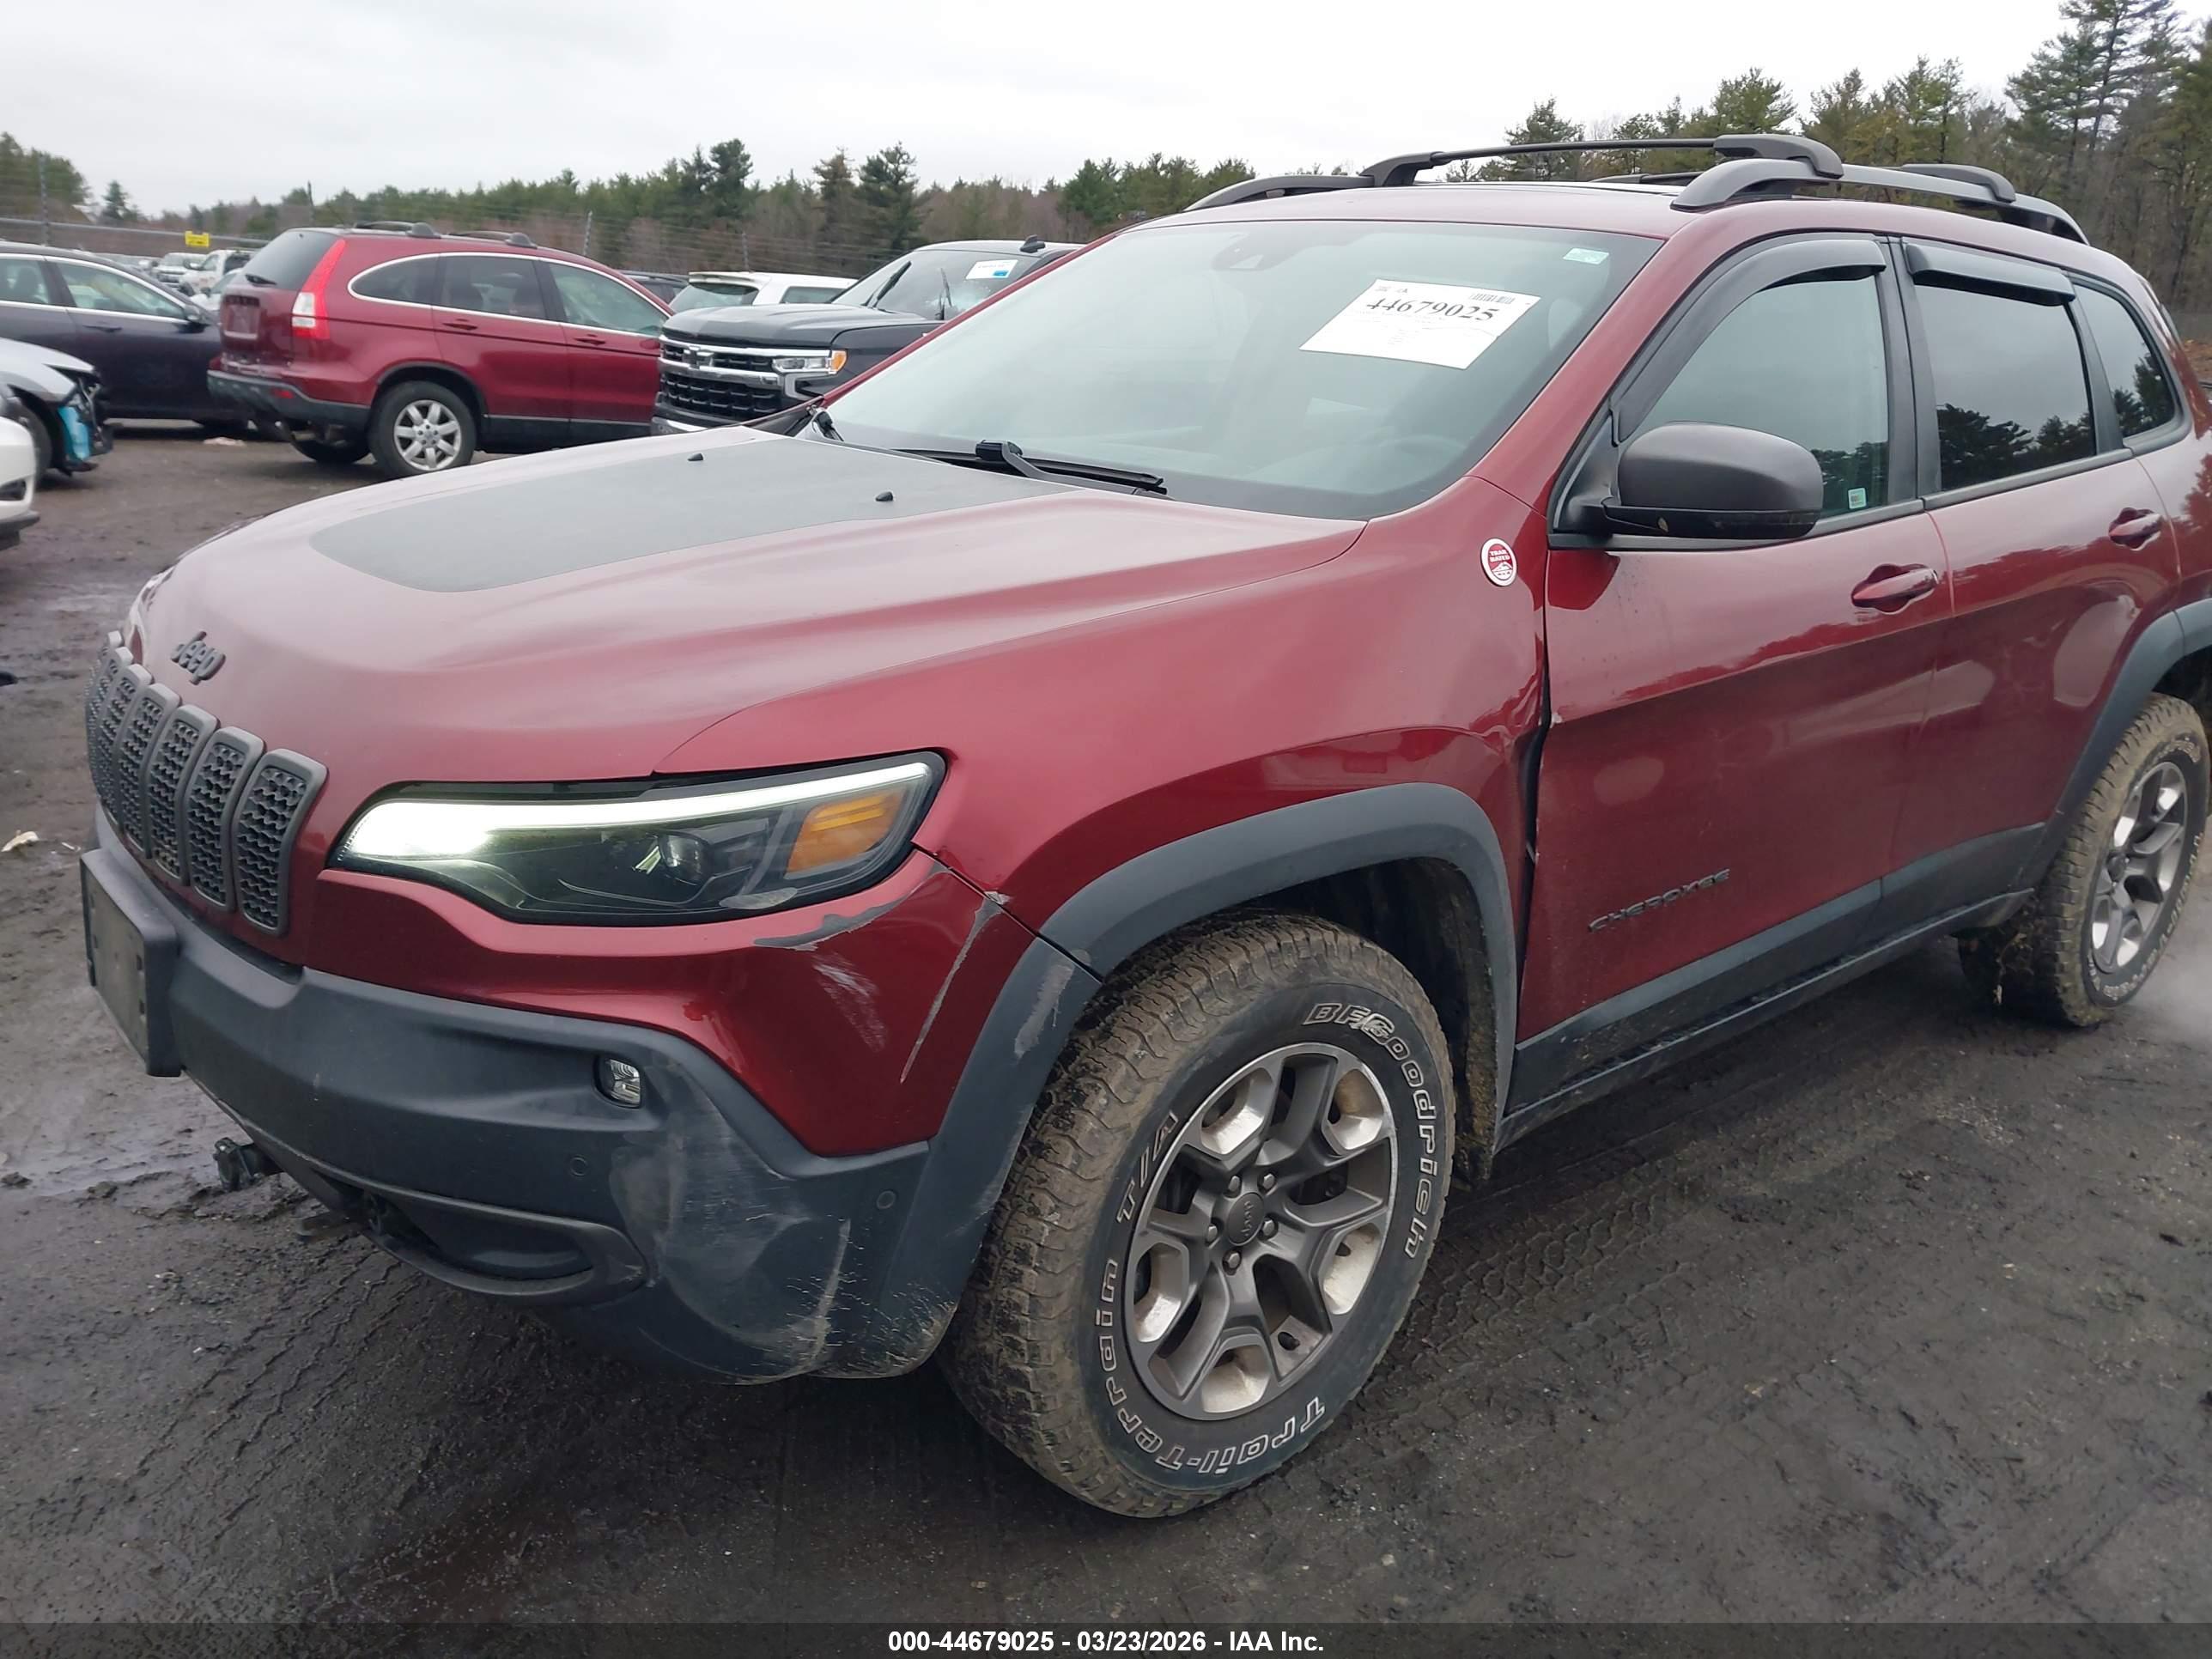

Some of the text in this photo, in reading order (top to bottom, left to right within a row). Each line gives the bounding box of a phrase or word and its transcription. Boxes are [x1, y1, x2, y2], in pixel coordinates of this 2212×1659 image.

[1366, 297, 1500, 321] 44679025
[171, 630, 227, 686] Jeep
[1588, 868, 1730, 933] CHEROKEE
[1094, 1109, 1326, 1475] Trail-Terrain T/A
